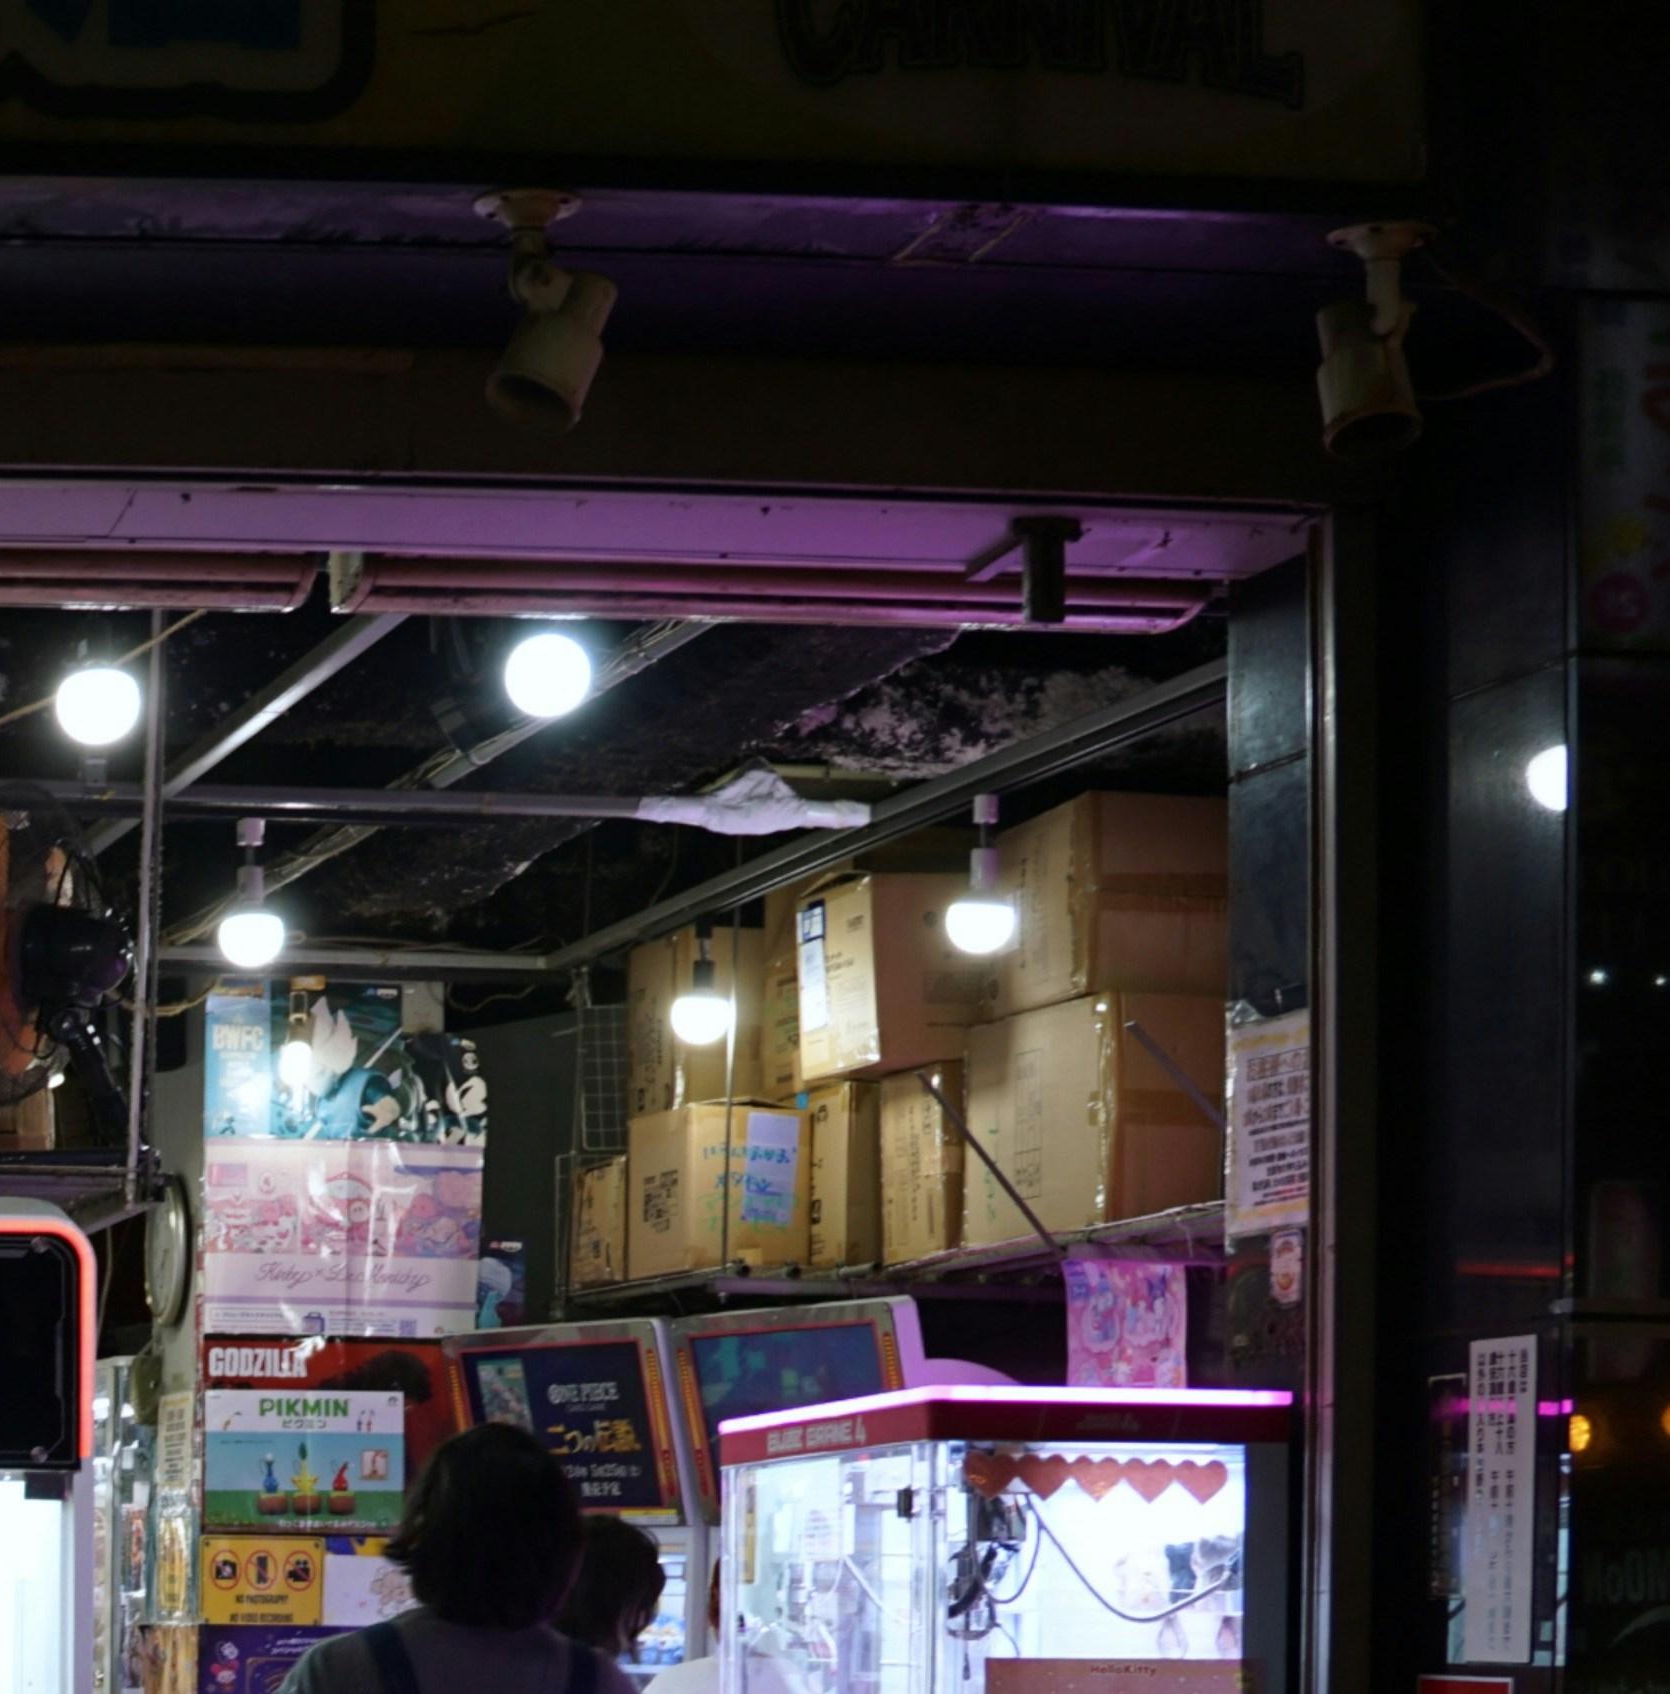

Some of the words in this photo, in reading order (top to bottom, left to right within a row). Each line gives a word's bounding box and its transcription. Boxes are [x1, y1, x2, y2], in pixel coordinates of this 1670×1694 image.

[209, 1347, 308, 1378] GODZILLA
[259, 1398, 349, 1417] PIKMIN
[282, 1419, 327, 1430] ピクミン
